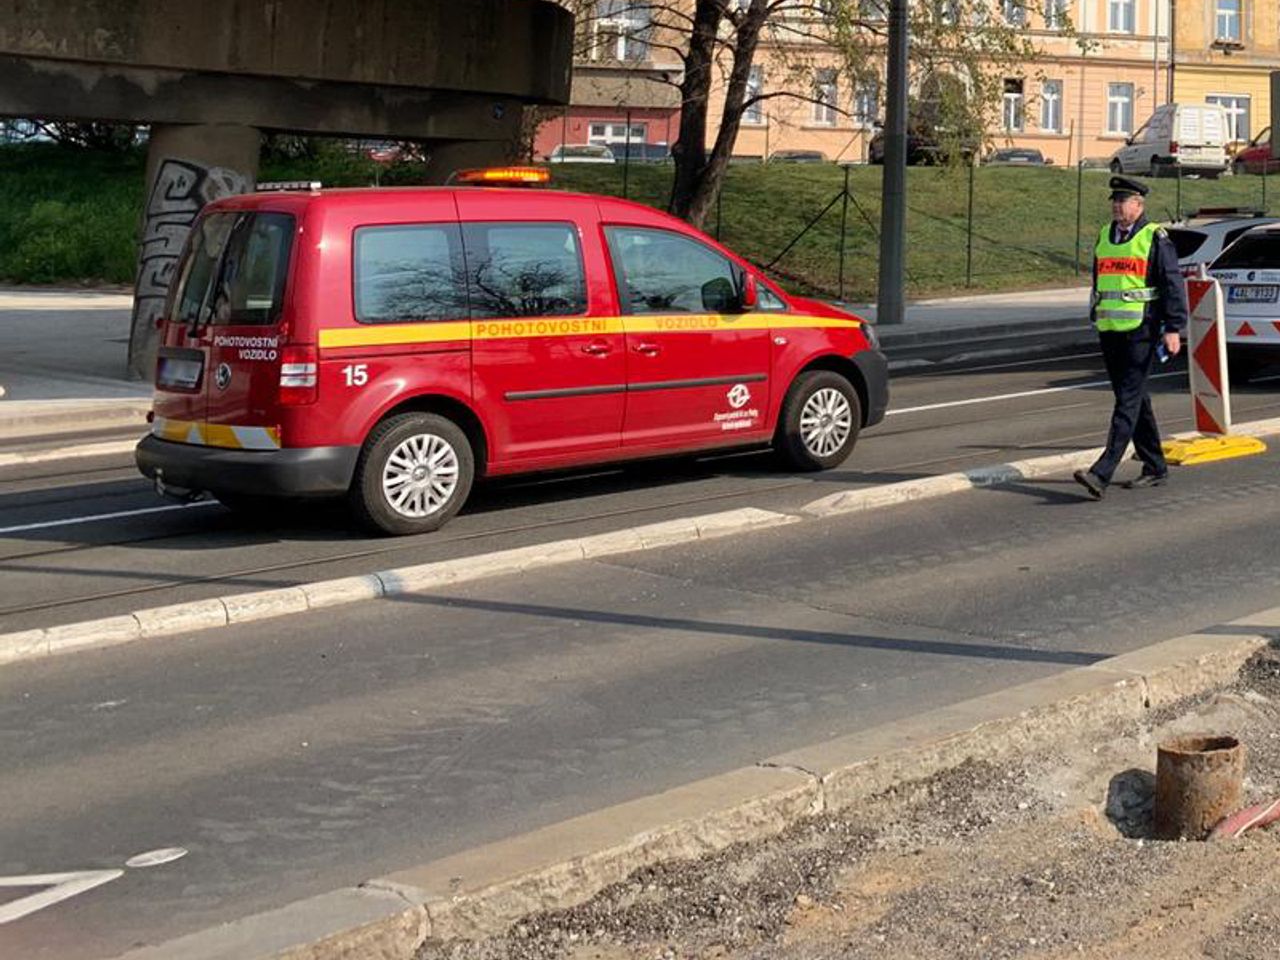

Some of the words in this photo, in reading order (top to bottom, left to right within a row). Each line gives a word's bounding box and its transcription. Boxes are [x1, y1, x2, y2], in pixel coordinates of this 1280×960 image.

[656, 316, 718, 330] VOZIDLO
[238, 349, 278, 361] VOZIDLO
[342, 364, 368, 386] 15
